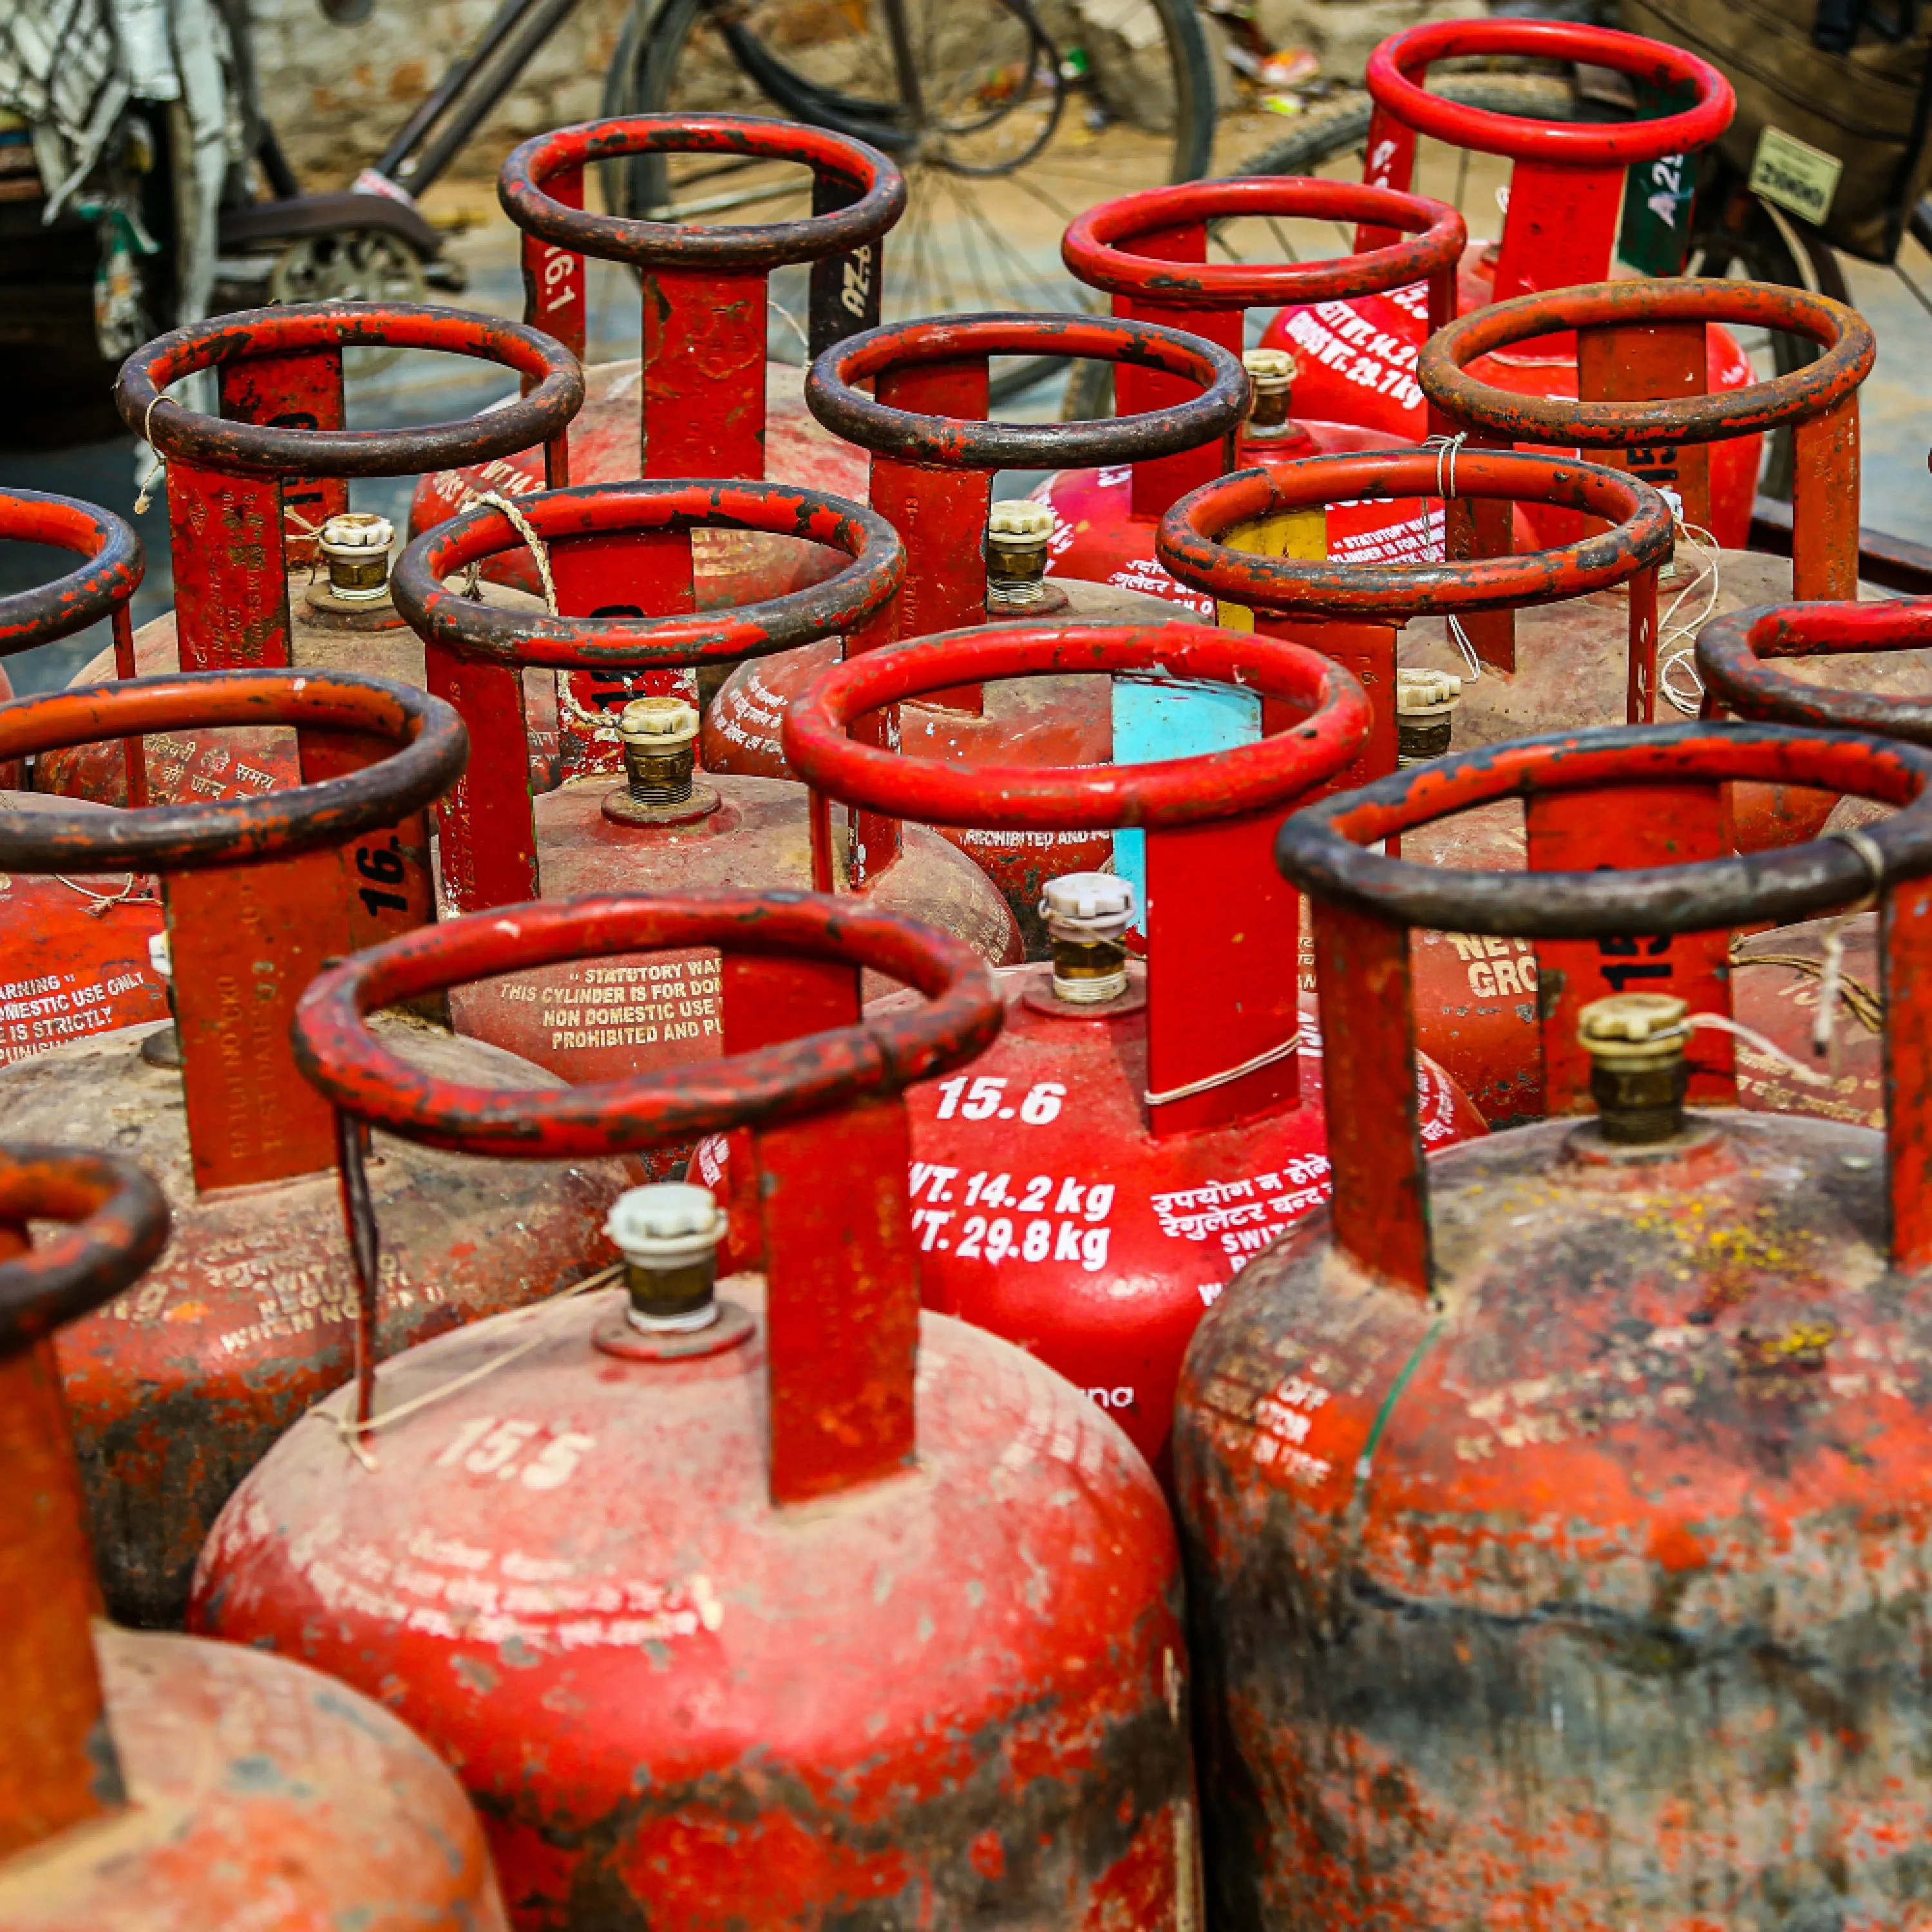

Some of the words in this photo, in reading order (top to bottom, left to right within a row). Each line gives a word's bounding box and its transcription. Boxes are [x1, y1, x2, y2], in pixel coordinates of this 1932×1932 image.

[71, 982, 107, 1007] USE
[107, 971, 144, 996] ONLY
[584, 964, 684, 984] STATUTORY
[500, 983, 538, 1002] THIS
[540, 987, 625, 1003] CYLINDER
[629, 985, 647, 1002] IS
[650, 982, 687, 1000] FOR
[9, 1023, 29, 1042] IS
[32, 1005, 113, 1039] STRICTLY
[542, 1009, 581, 1027] NON
[584, 1002, 676, 1027] DOMESTIC
[679, 998, 716, 1018] USE
[551, 1025, 658, 1050] PROHIBITED
[663, 1021, 699, 1042] AND
[936, 1075, 1067, 1125] 15.6
[963, 1170, 1054, 1213] 14.2
[1054, 1176, 1116, 1222] kg
[1149, 1179, 1255, 1213] उपयोग
[1159, 1202, 1268, 1241] रेगुलेटर
[955, 1215, 1052, 1267] 29.8
[1054, 1220, 1112, 1272] kg
[435, 1415, 598, 1492] 15.5
